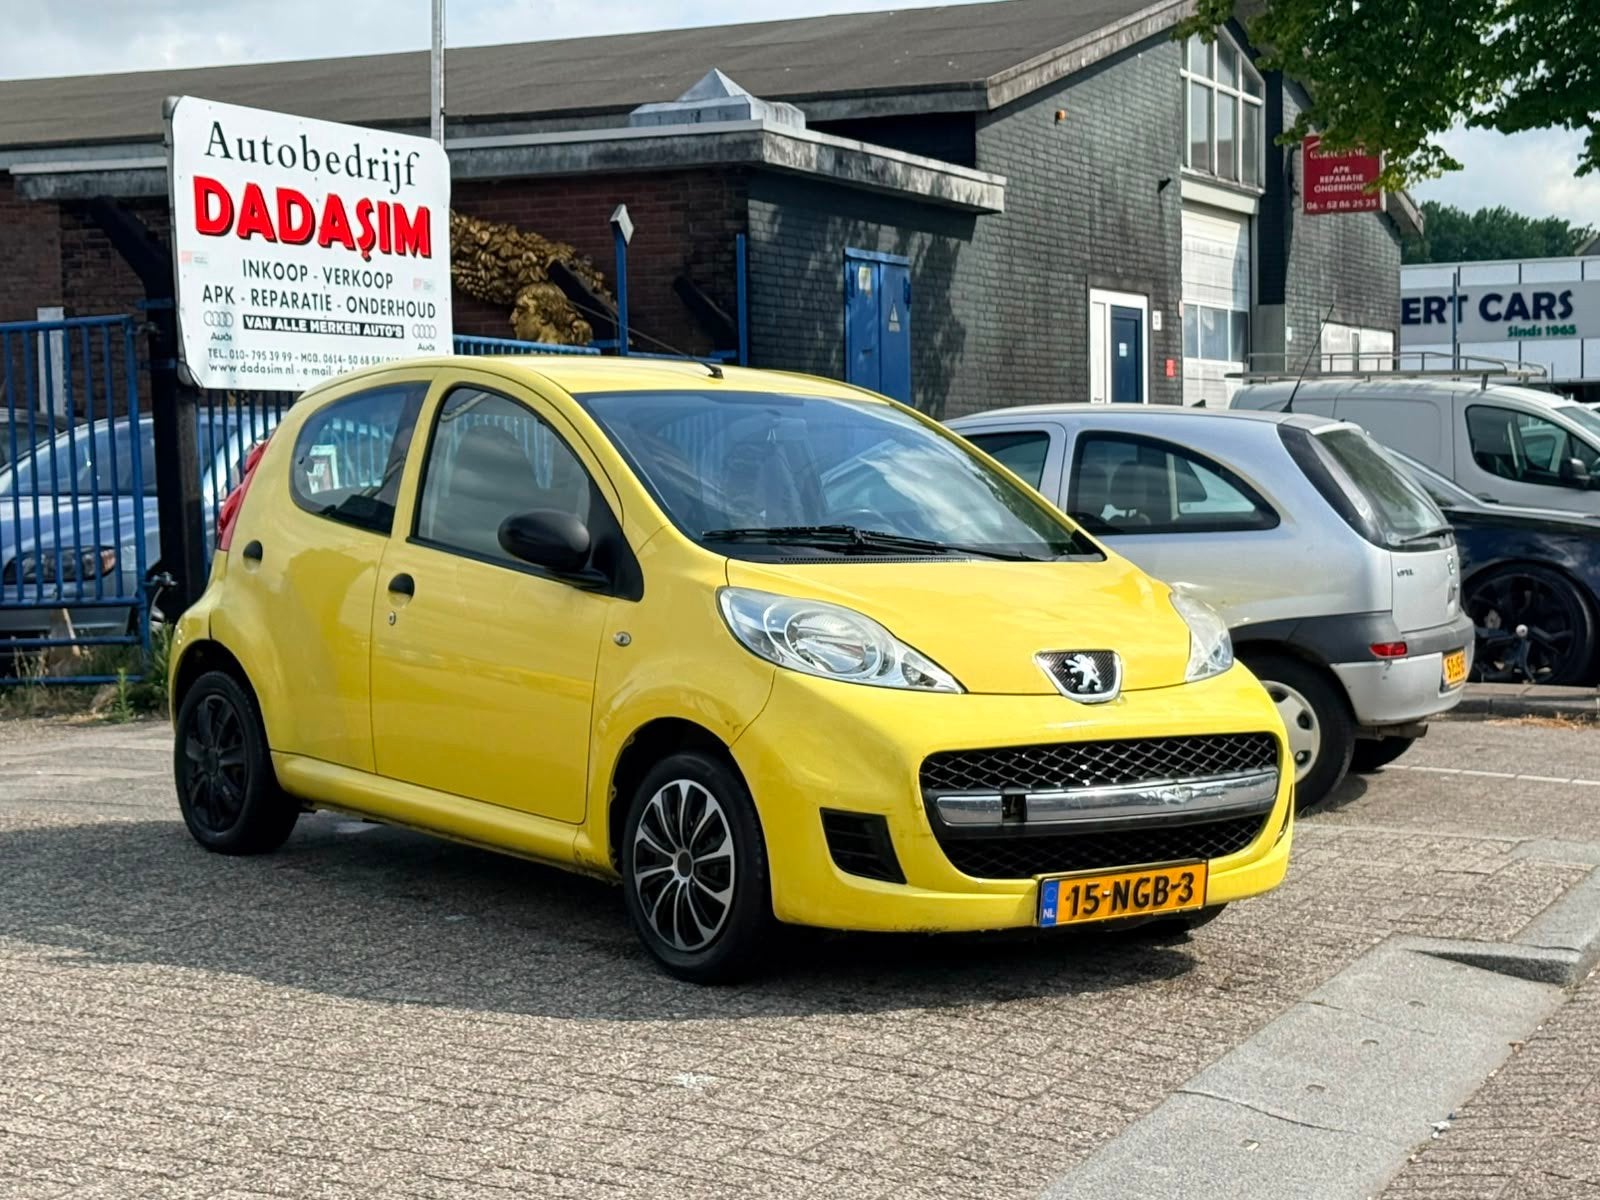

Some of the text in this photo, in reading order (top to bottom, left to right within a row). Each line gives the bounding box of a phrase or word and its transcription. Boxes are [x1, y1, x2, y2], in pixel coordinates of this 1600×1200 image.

[204, 121, 420, 194] Autobedrijf
[1332, 166, 1350, 174] APK
[1319, 174, 1364, 183] REPARATIE
[242, 259, 309, 282] INKOOP
[323, 266, 393, 289] VERKOOP
[203, 285, 236, 305] APK
[251, 288, 332, 312] REPARATIE
[346, 296, 436, 319] ONDERHOUD
[1479, 289, 1574, 322] CARS
[245, 316, 404, 338] VAN ALLE MERKEN AUTO'S
[1507, 324, 1577, 337] Sinds 1965
[211, 332, 232, 341] Audi
[208, 348, 227, 359] TEL.
[417, 343, 435, 352] Audi
[1070, 871, 1195, 917] 15-NGB-3
[1042, 908, 1055, 918] NL
